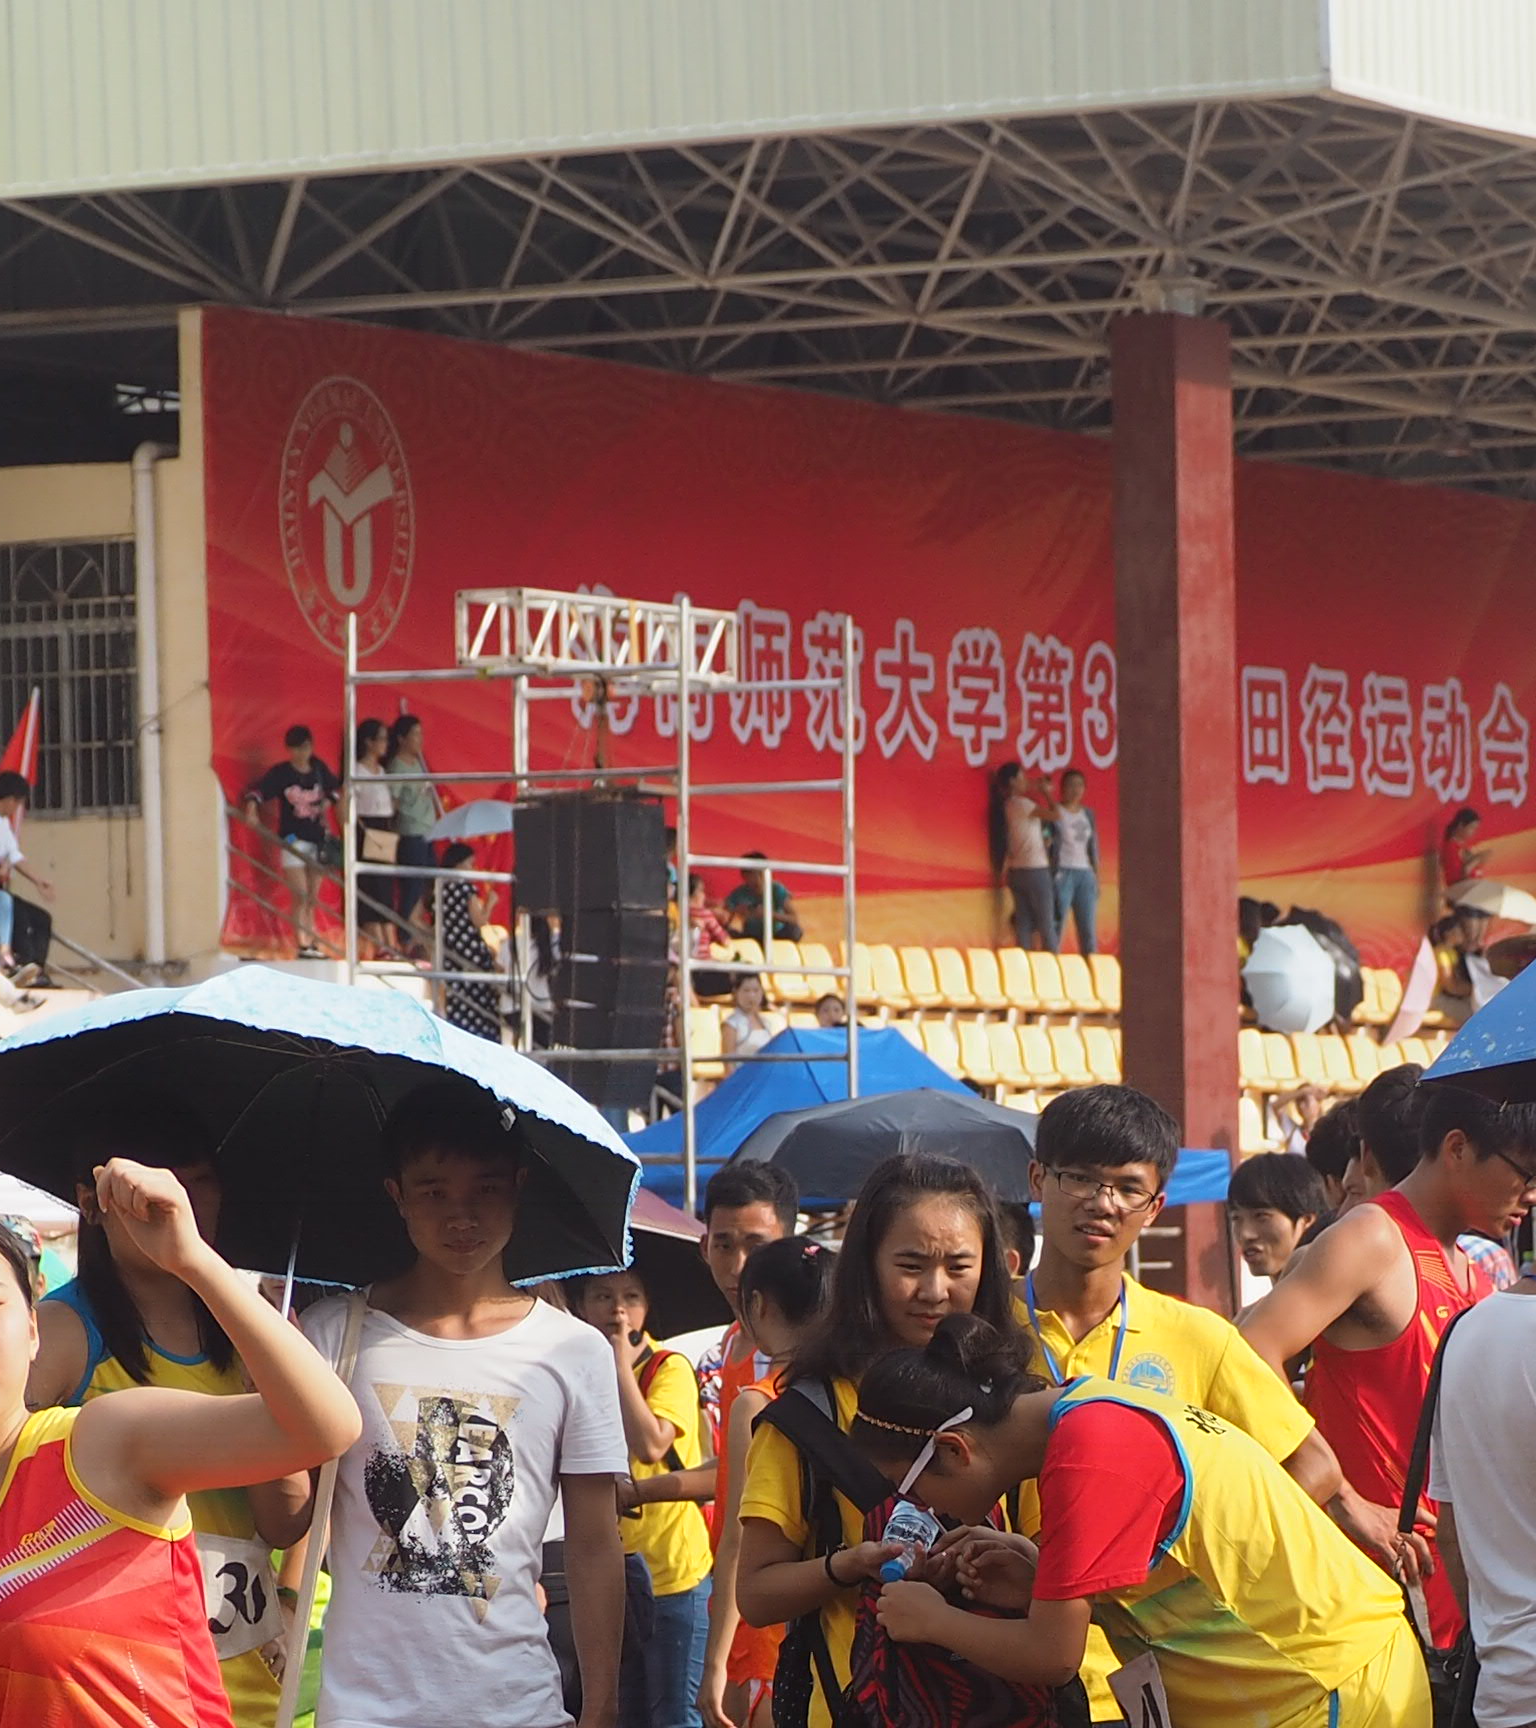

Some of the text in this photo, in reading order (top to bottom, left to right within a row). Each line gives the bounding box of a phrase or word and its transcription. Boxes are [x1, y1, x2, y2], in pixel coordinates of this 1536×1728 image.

[1241, 663, 1530, 808] 田径运动会
